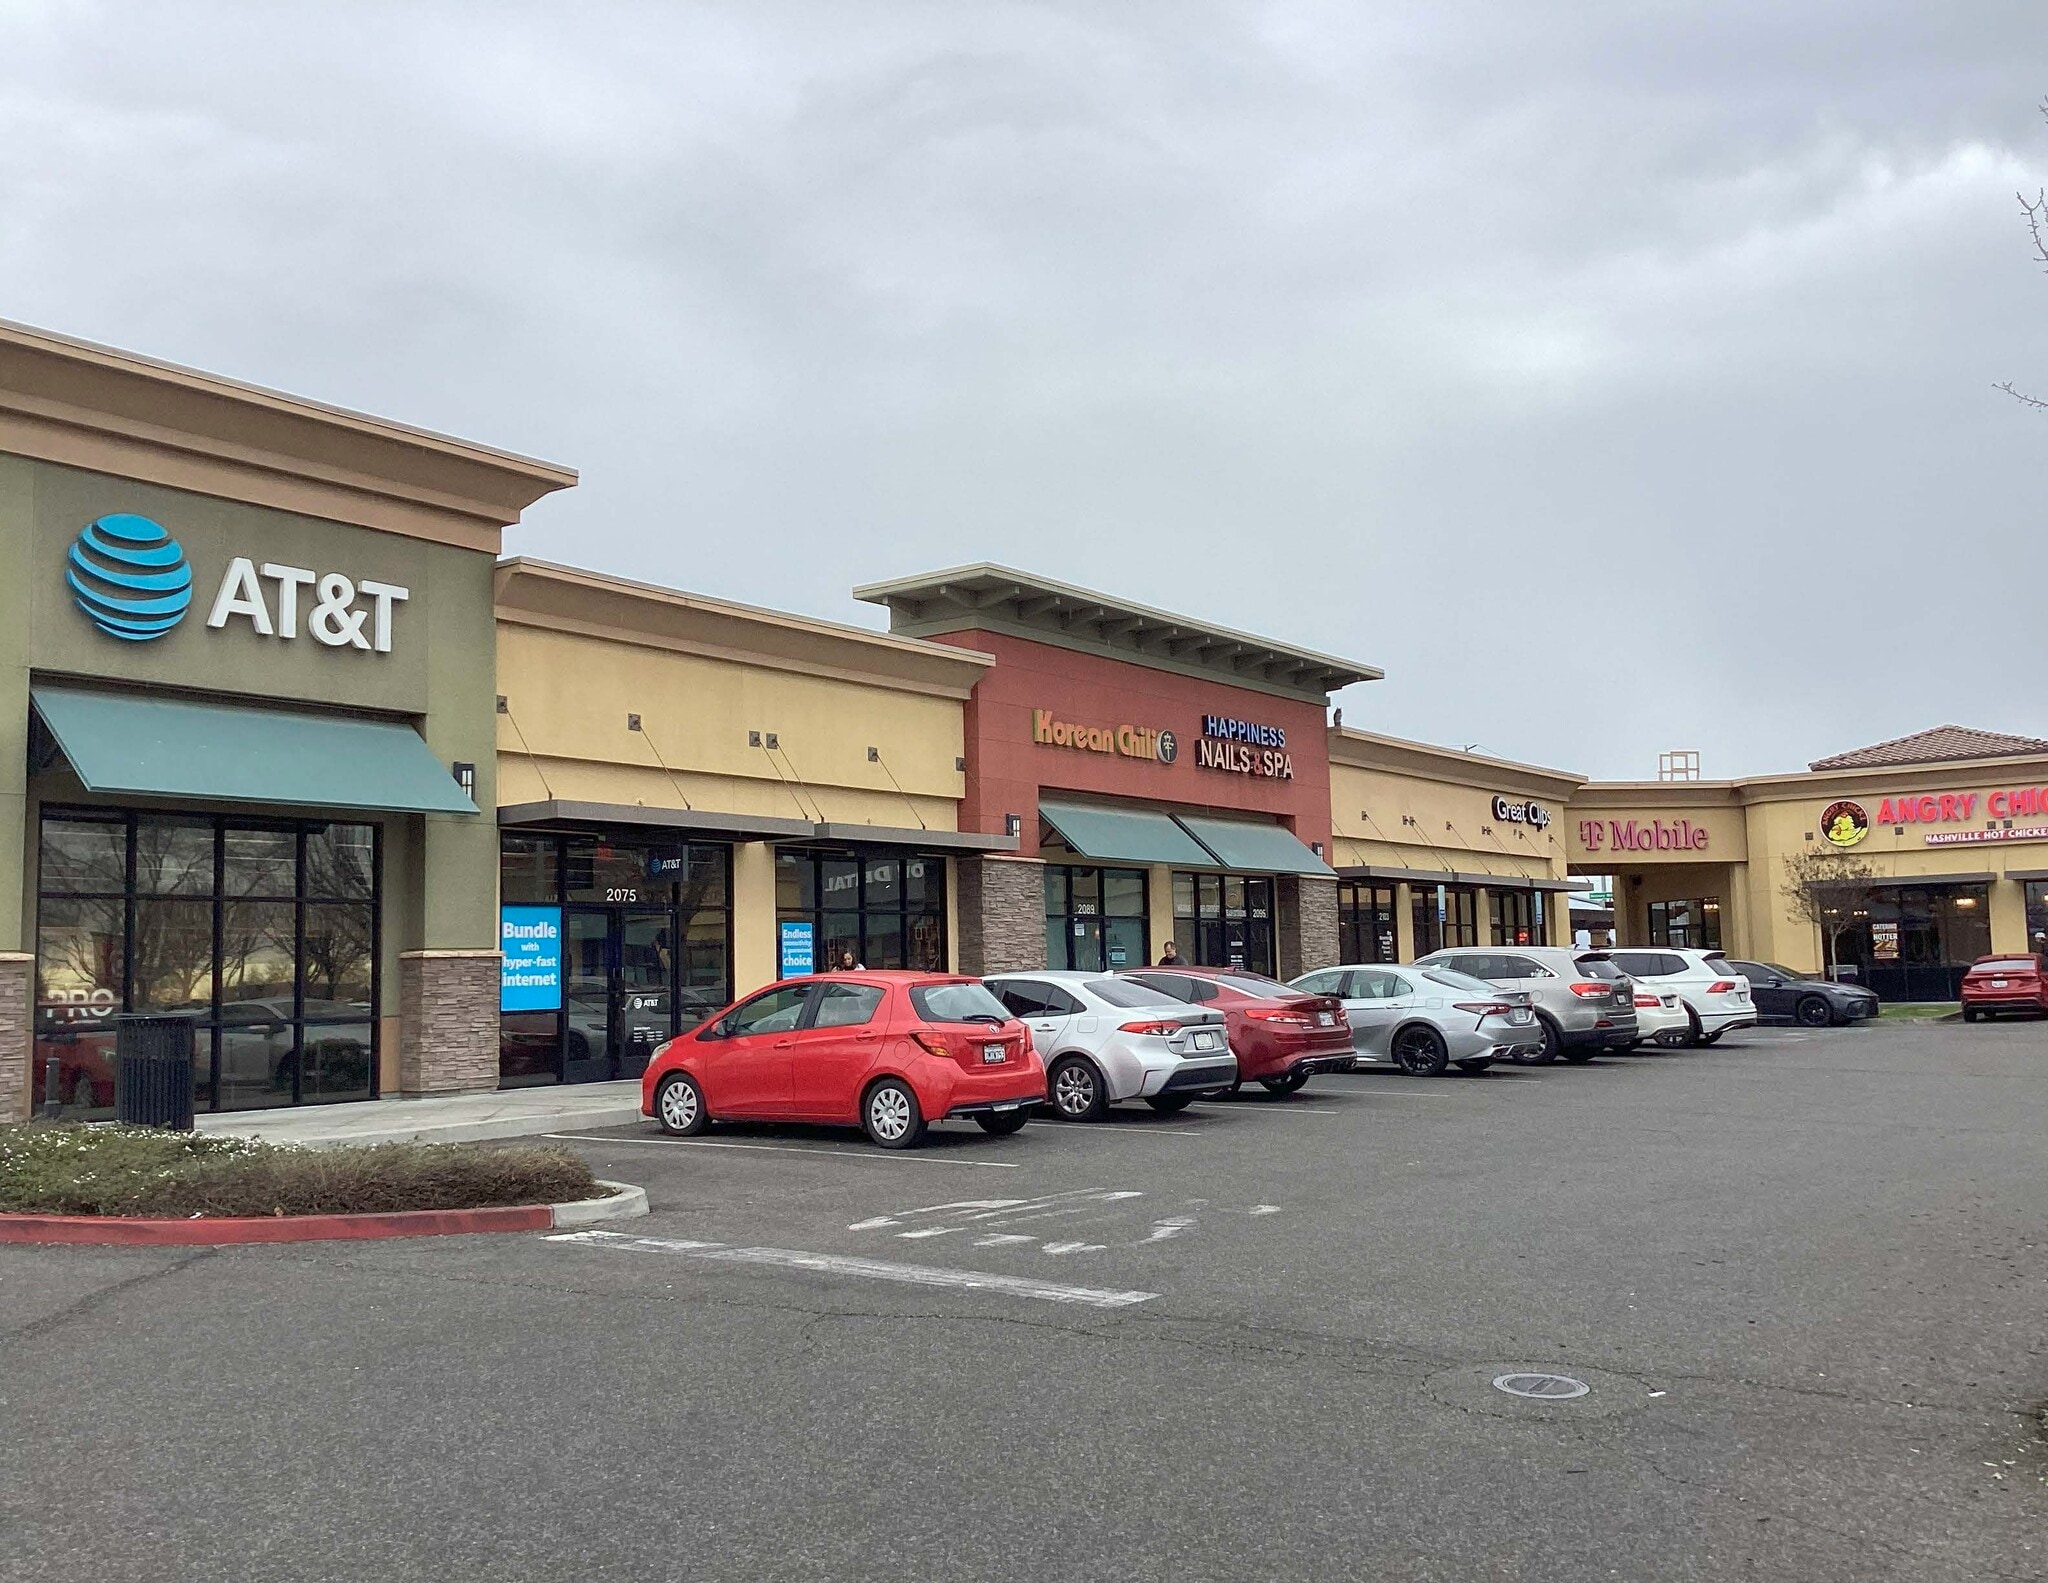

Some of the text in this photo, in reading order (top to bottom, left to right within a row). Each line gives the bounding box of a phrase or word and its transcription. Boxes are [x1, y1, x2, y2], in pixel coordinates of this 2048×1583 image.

[207, 557, 409, 652] AT&T
[1033, 709, 1158, 760] Korean Chili
[1203, 714, 1286, 748] HAPPINESS
[1198, 739, 1294, 779] NAILS & SPA
[1494, 796, 1552, 830] Great Clips
[1877, 792, 1978, 824] ANGRY
[1580, 819, 1709, 850] T Mobile
[1925, 827, 2048, 843] NASHVILLE HOT CHICKE
[661, 859, 681, 870] AT&T
[606, 888, 637, 902] 2075
[1077, 904, 1096, 914] 2089
[503, 922, 557, 939] Bundle
[783, 928, 811, 939] Endless
[520, 942, 540, 952] with
[502, 956, 557, 970] hyper-fast
[783, 955, 812, 966] choice
[502, 973, 557, 987] internet
